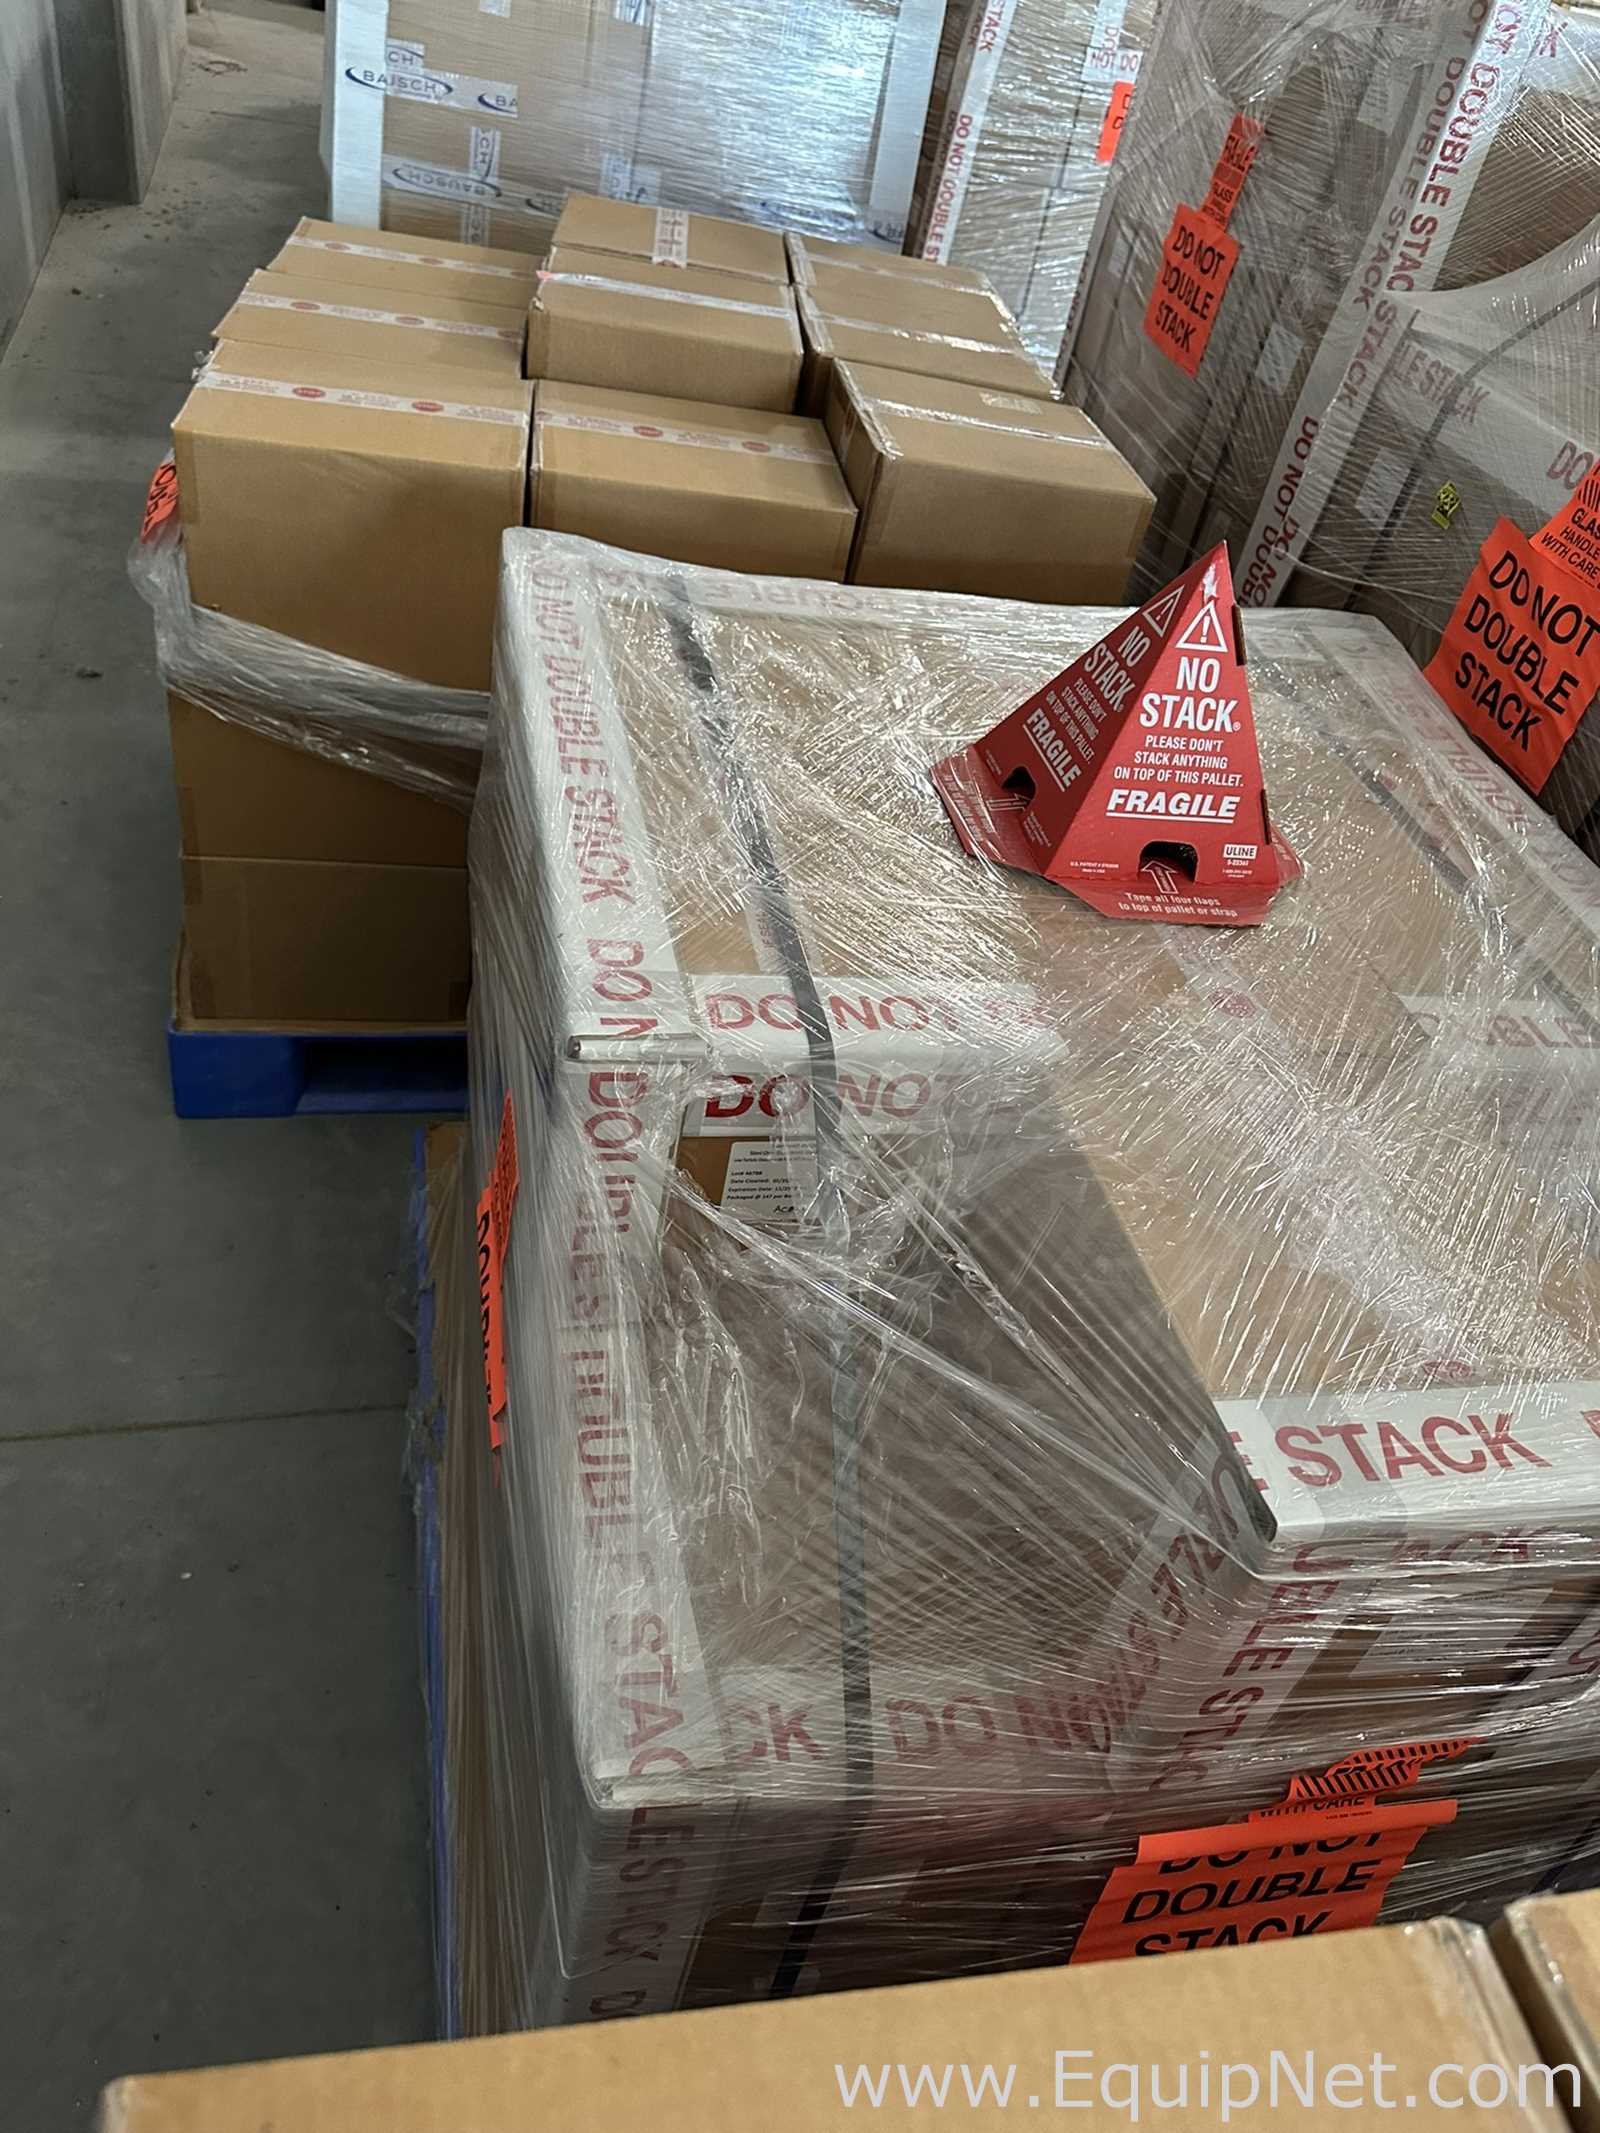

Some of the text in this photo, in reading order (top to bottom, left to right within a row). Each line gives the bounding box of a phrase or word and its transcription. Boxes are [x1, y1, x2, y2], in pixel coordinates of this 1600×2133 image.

[1172, 225, 1195, 259] DO
[1155, 300, 1196, 352] STACK
[1489, 551, 1600, 657] DO NOT
[1118, 626, 1150, 667] NO
[1464, 594, 1579, 715] DOUBLE
[1176, 656, 1221, 693] NO
[1455, 652, 1542, 752] STACK
[1026, 708, 1082, 788] FRAGILE
[1134, 751, 1229, 769] STACK ANYTHING
[1145, 735, 1224, 752] PLEASE DON'T
[1114, 766, 1245, 787] ON TOP OF THIS PALLET.
[1106, 788, 1241, 818] FRAGILE
[1225, 846, 1256, 857] ULINE
[1275, 1411, 1554, 1487] STACK
[1122, 1858, 1382, 1925] DOUBLE
